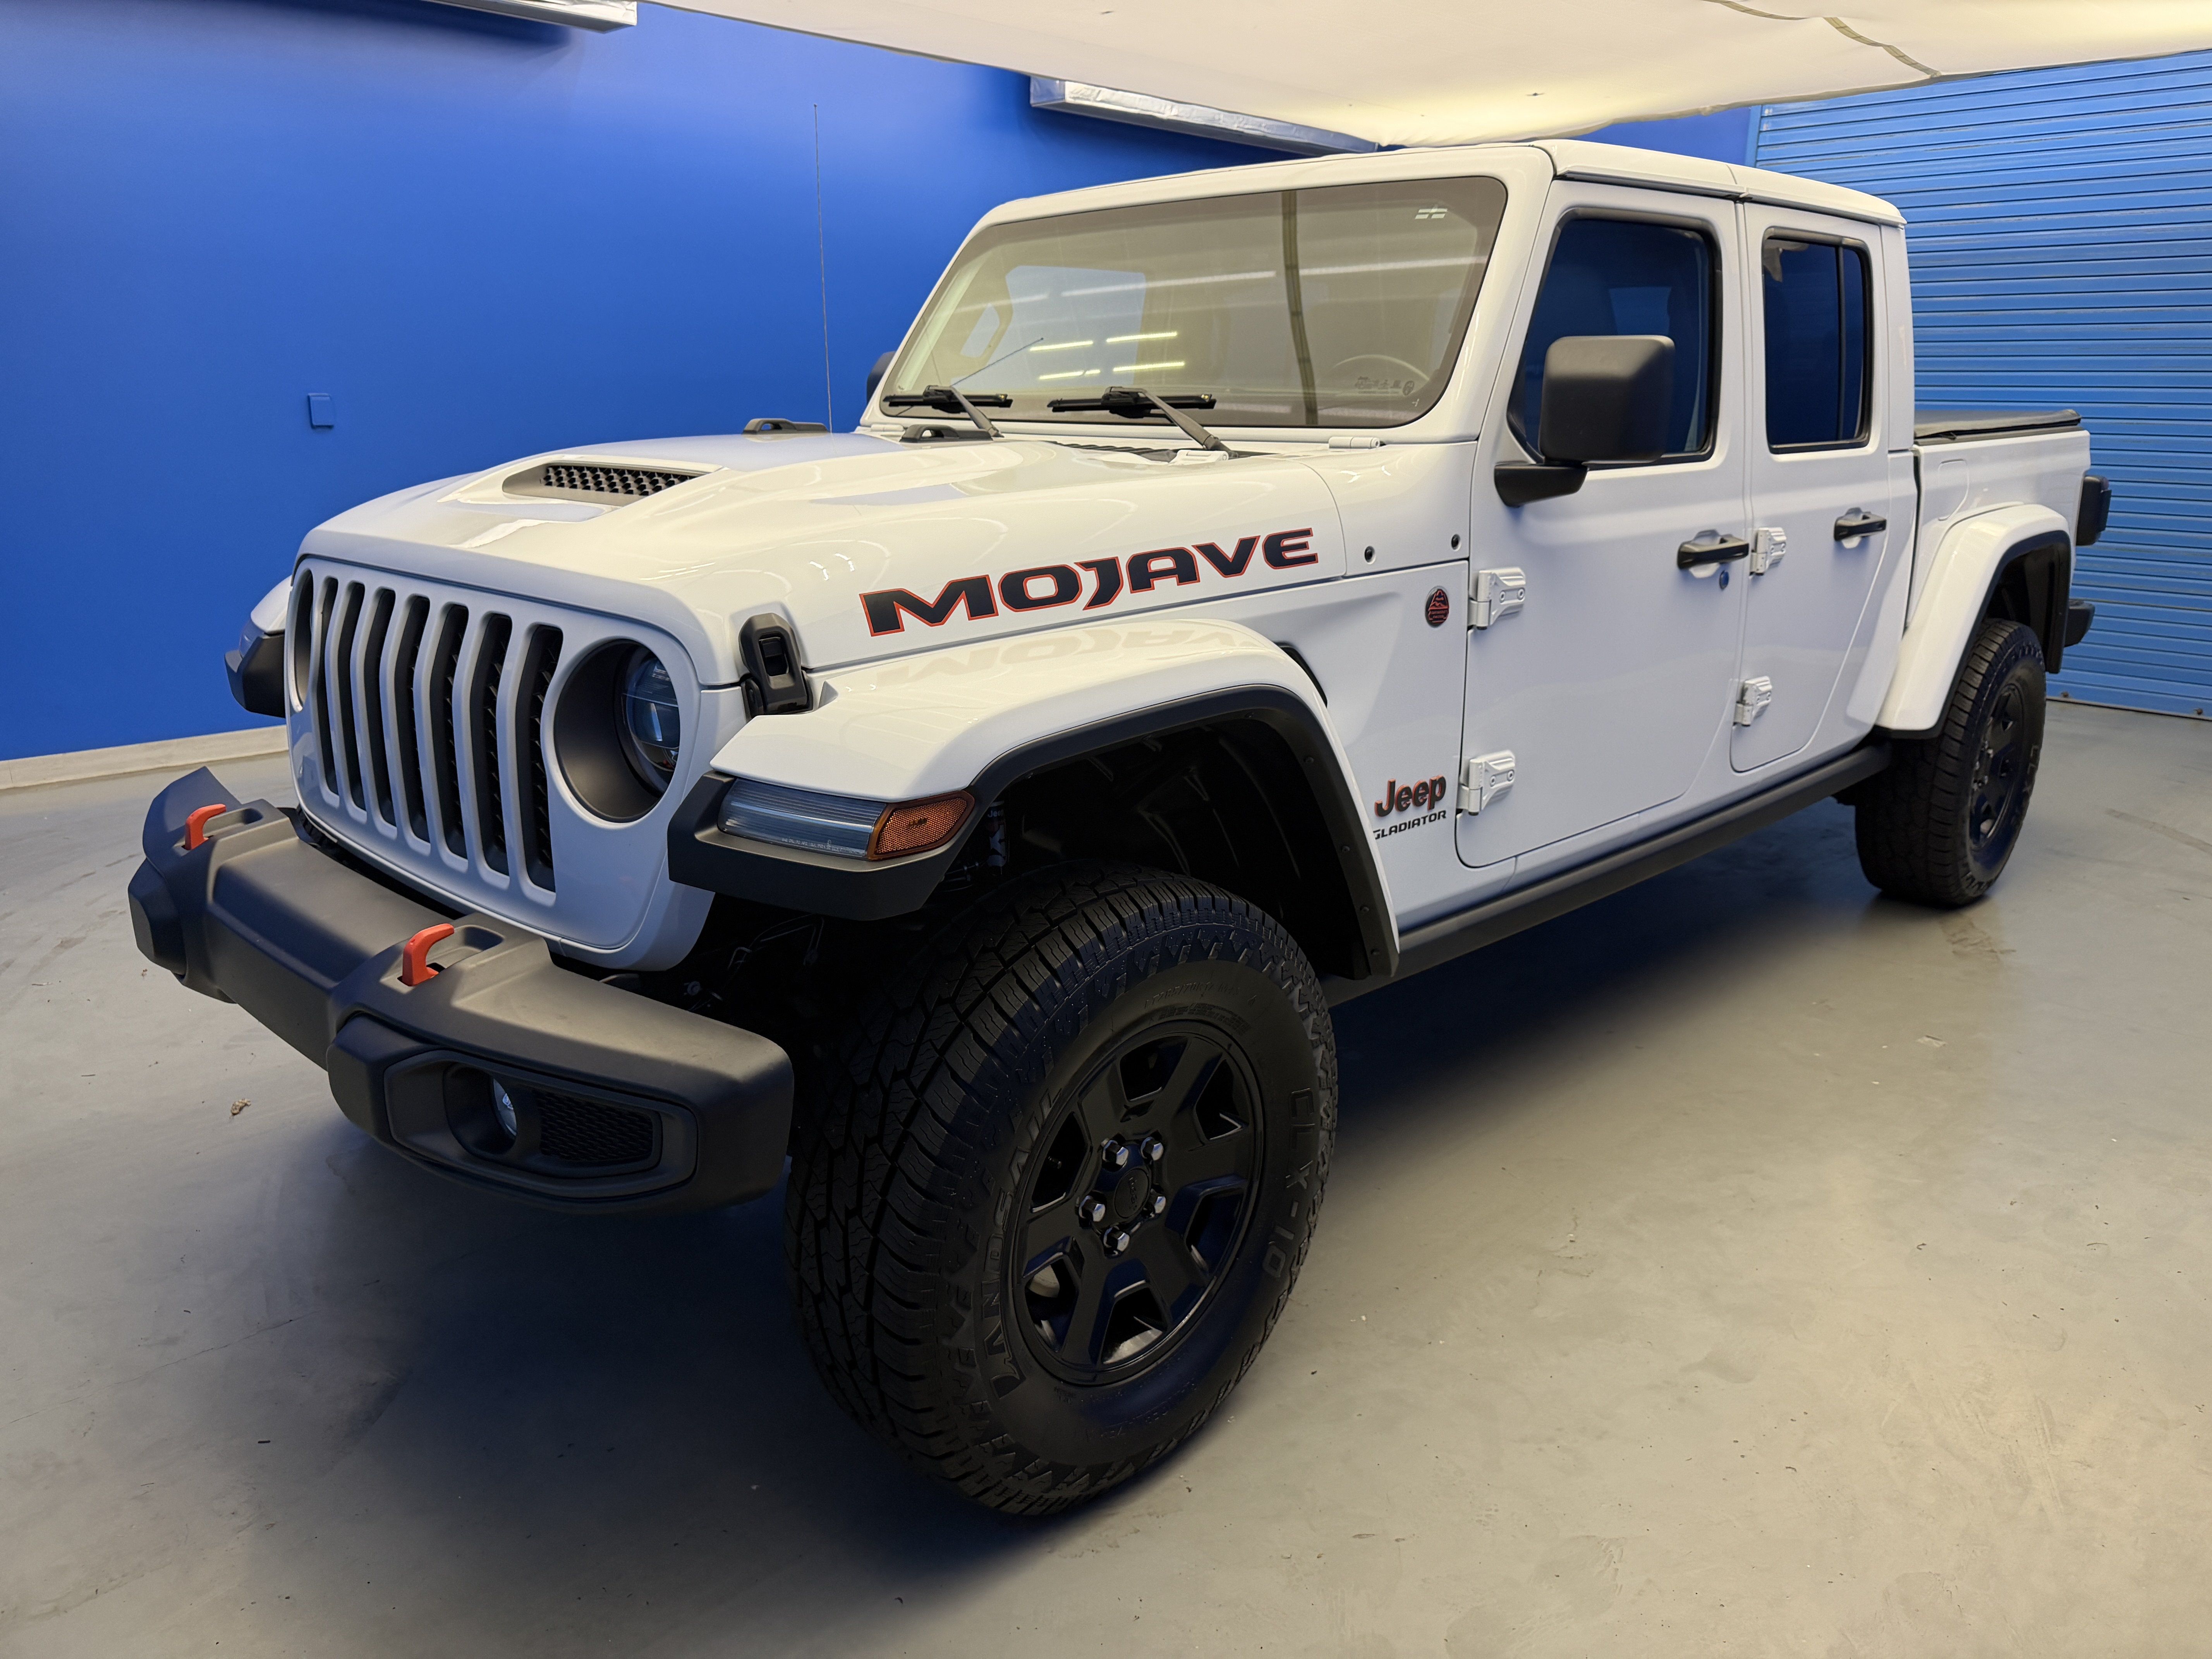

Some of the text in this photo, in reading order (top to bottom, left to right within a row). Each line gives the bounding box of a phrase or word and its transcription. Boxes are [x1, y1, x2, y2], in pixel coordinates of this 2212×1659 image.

[859, 527, 1318, 637] MOJAVE
[1373, 810, 1446, 840] GLADIATOR
[1375, 775, 1446, 817] Jeep
[1262, 1087, 1316, 1278] CLX-10
